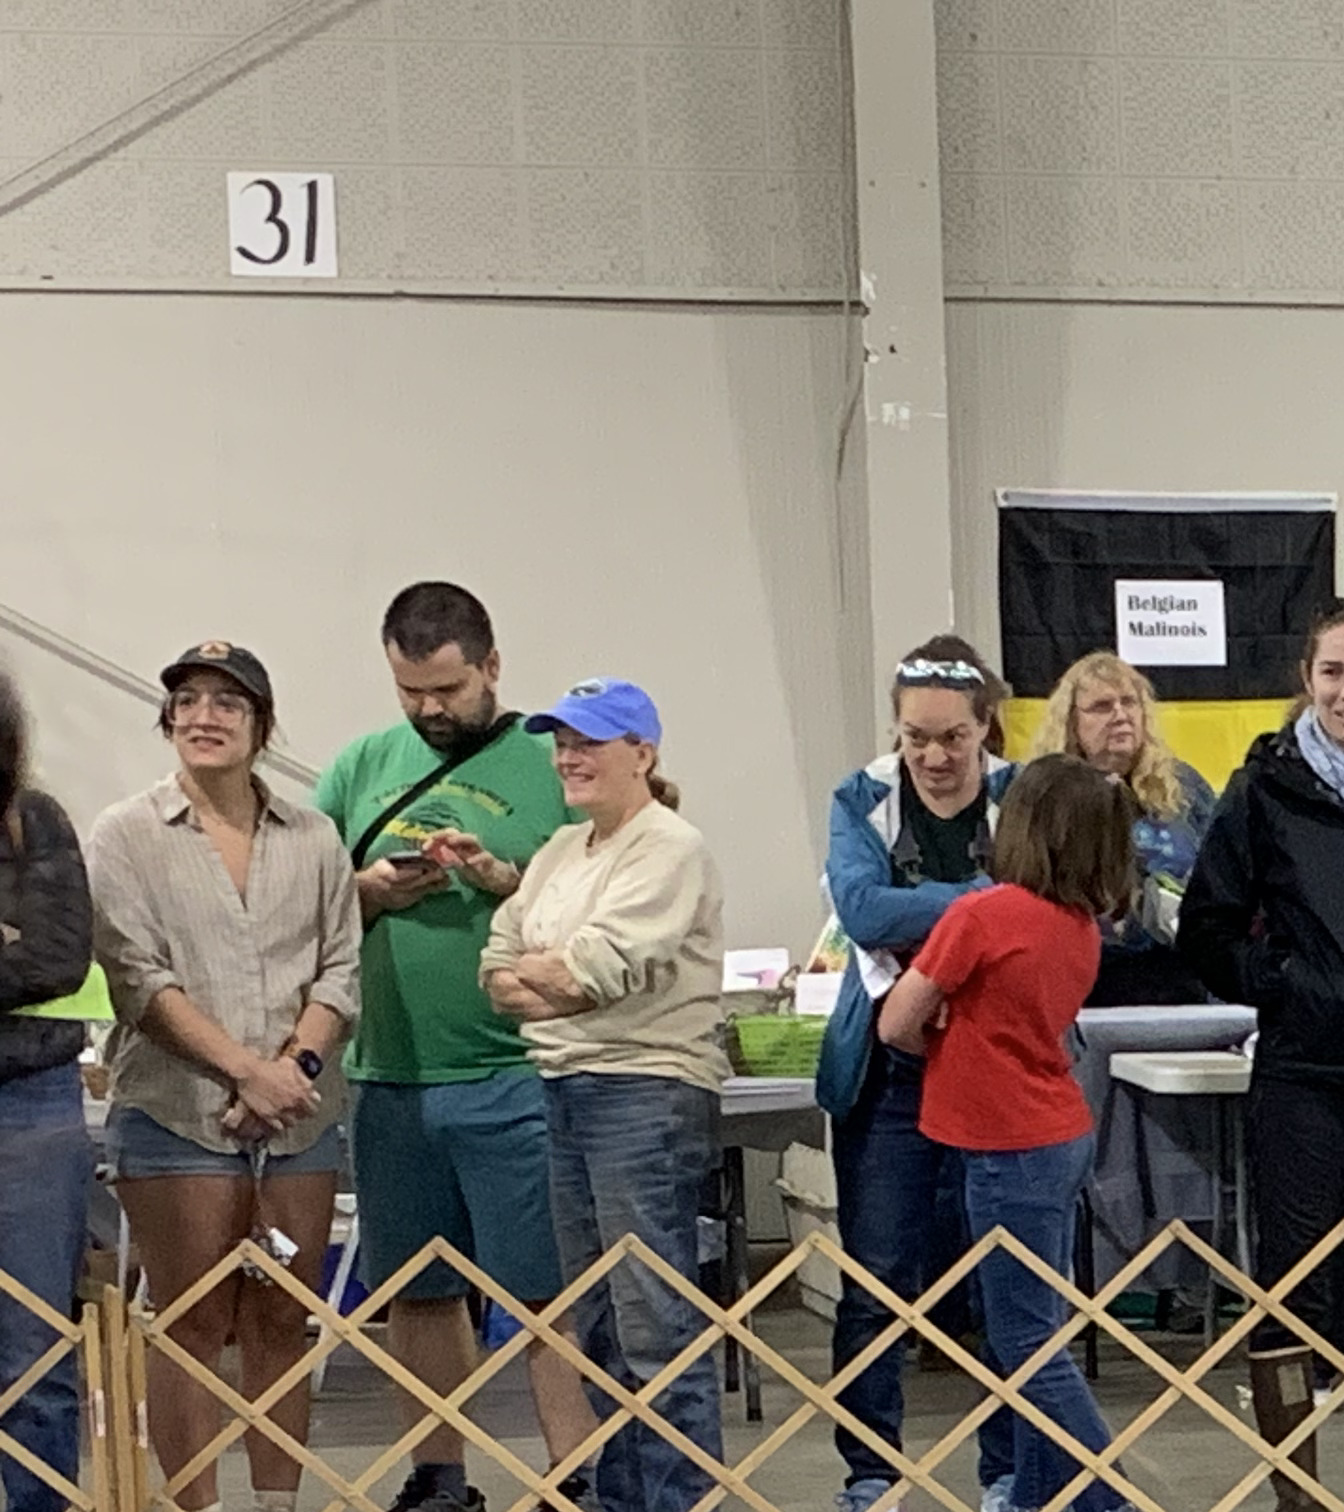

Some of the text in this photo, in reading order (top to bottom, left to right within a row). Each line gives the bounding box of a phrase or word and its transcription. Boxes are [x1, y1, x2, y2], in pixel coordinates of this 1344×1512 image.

[237, 179, 318, 265] 31
[1127, 594, 1198, 614] Belgian
[1128, 620, 1207, 637] Malinois
